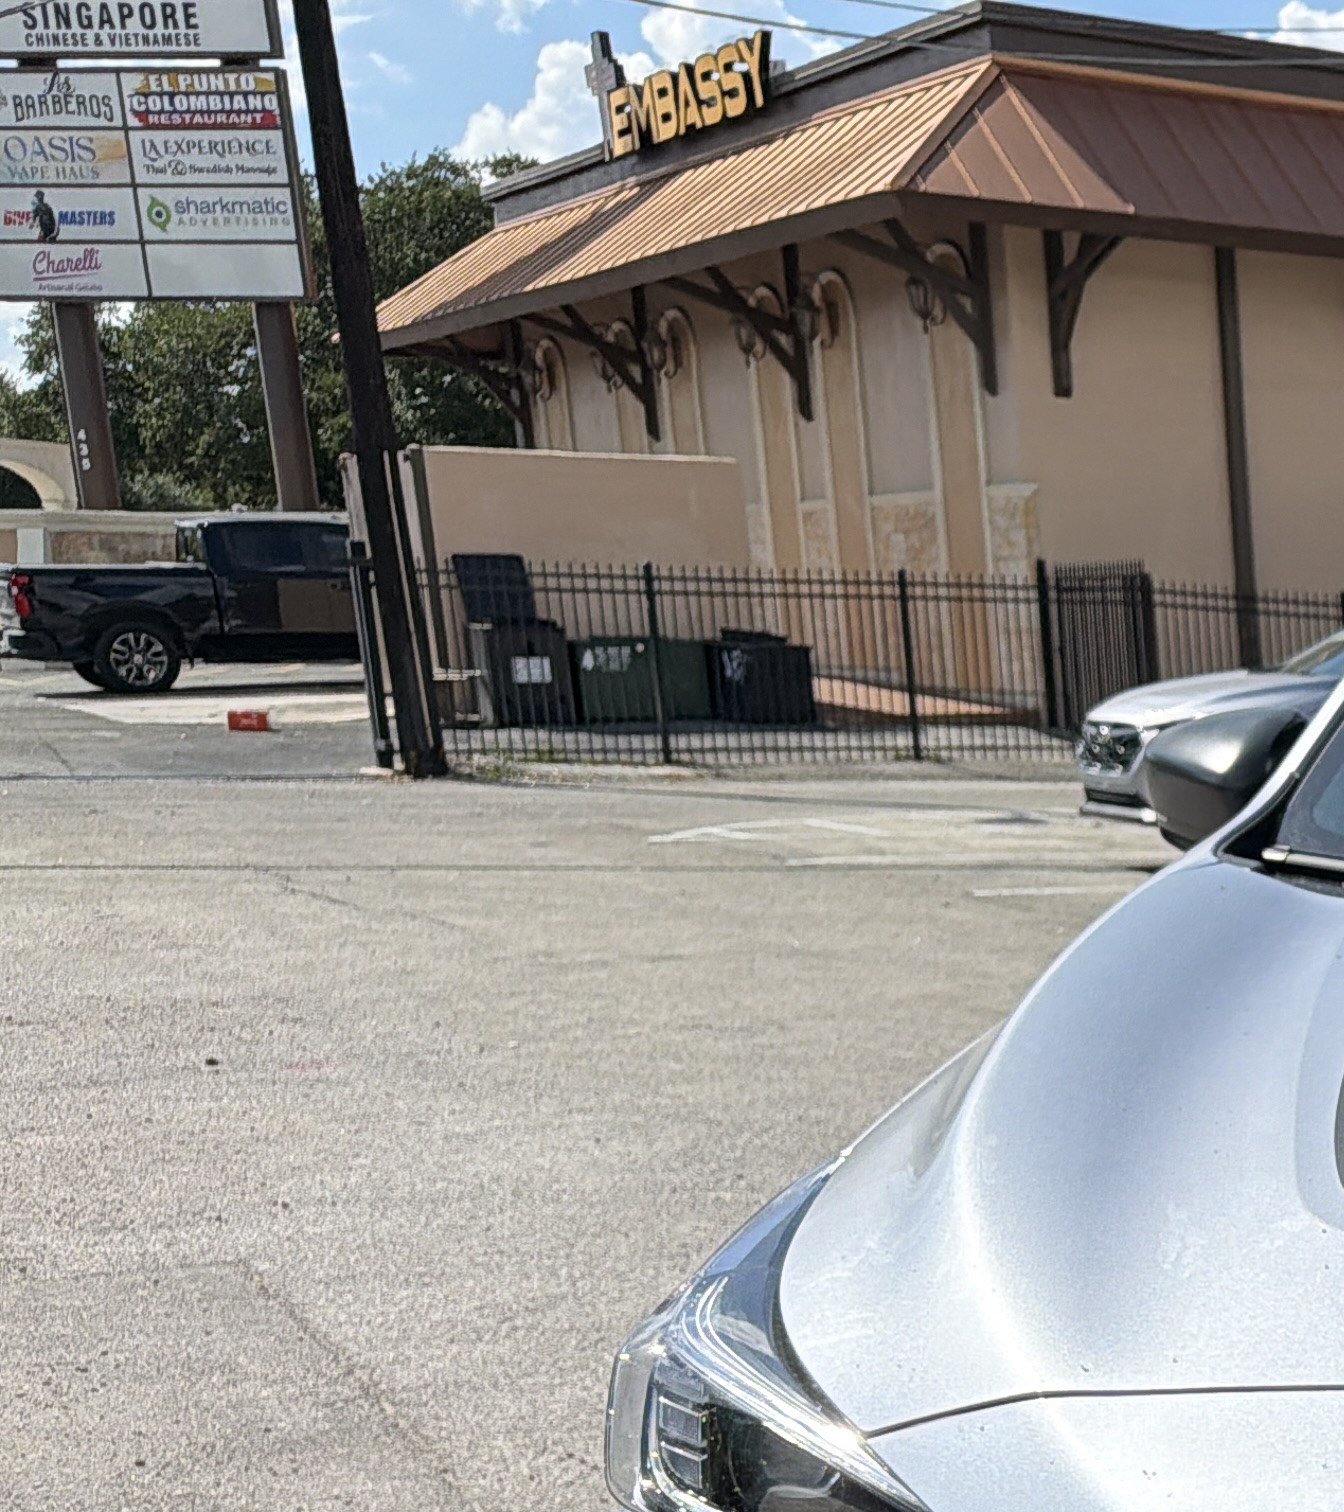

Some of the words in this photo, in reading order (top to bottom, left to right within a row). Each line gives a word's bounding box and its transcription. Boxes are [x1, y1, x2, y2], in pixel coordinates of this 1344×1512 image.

[22, 1, 200, 30] SINGAPORE
[24, 32, 90, 47] CHINESE
[94, 32, 103, 47] &
[107, 32, 202, 48] VIETNAMESE
[148, 73, 173, 92] EL
[178, 72, 256, 92] PUNTO
[132, 93, 278, 112] COLOMBIANO
[607, 29, 772, 159] EMBASSY
[12, 93, 114, 122] BARBEROS
[148, 112, 264, 125] RESTAURANT
[4, 135, 96, 162] OASIS
[164, 137, 277, 159] EXPERIENCE
[7, 165, 49, 179] VAPE
[55, 165, 100, 180] HAUS
[174, 196, 288, 215] sharkmatic
[58, 209, 116, 227] MASTERS
[177, 216, 291, 227] ADVERTISING
